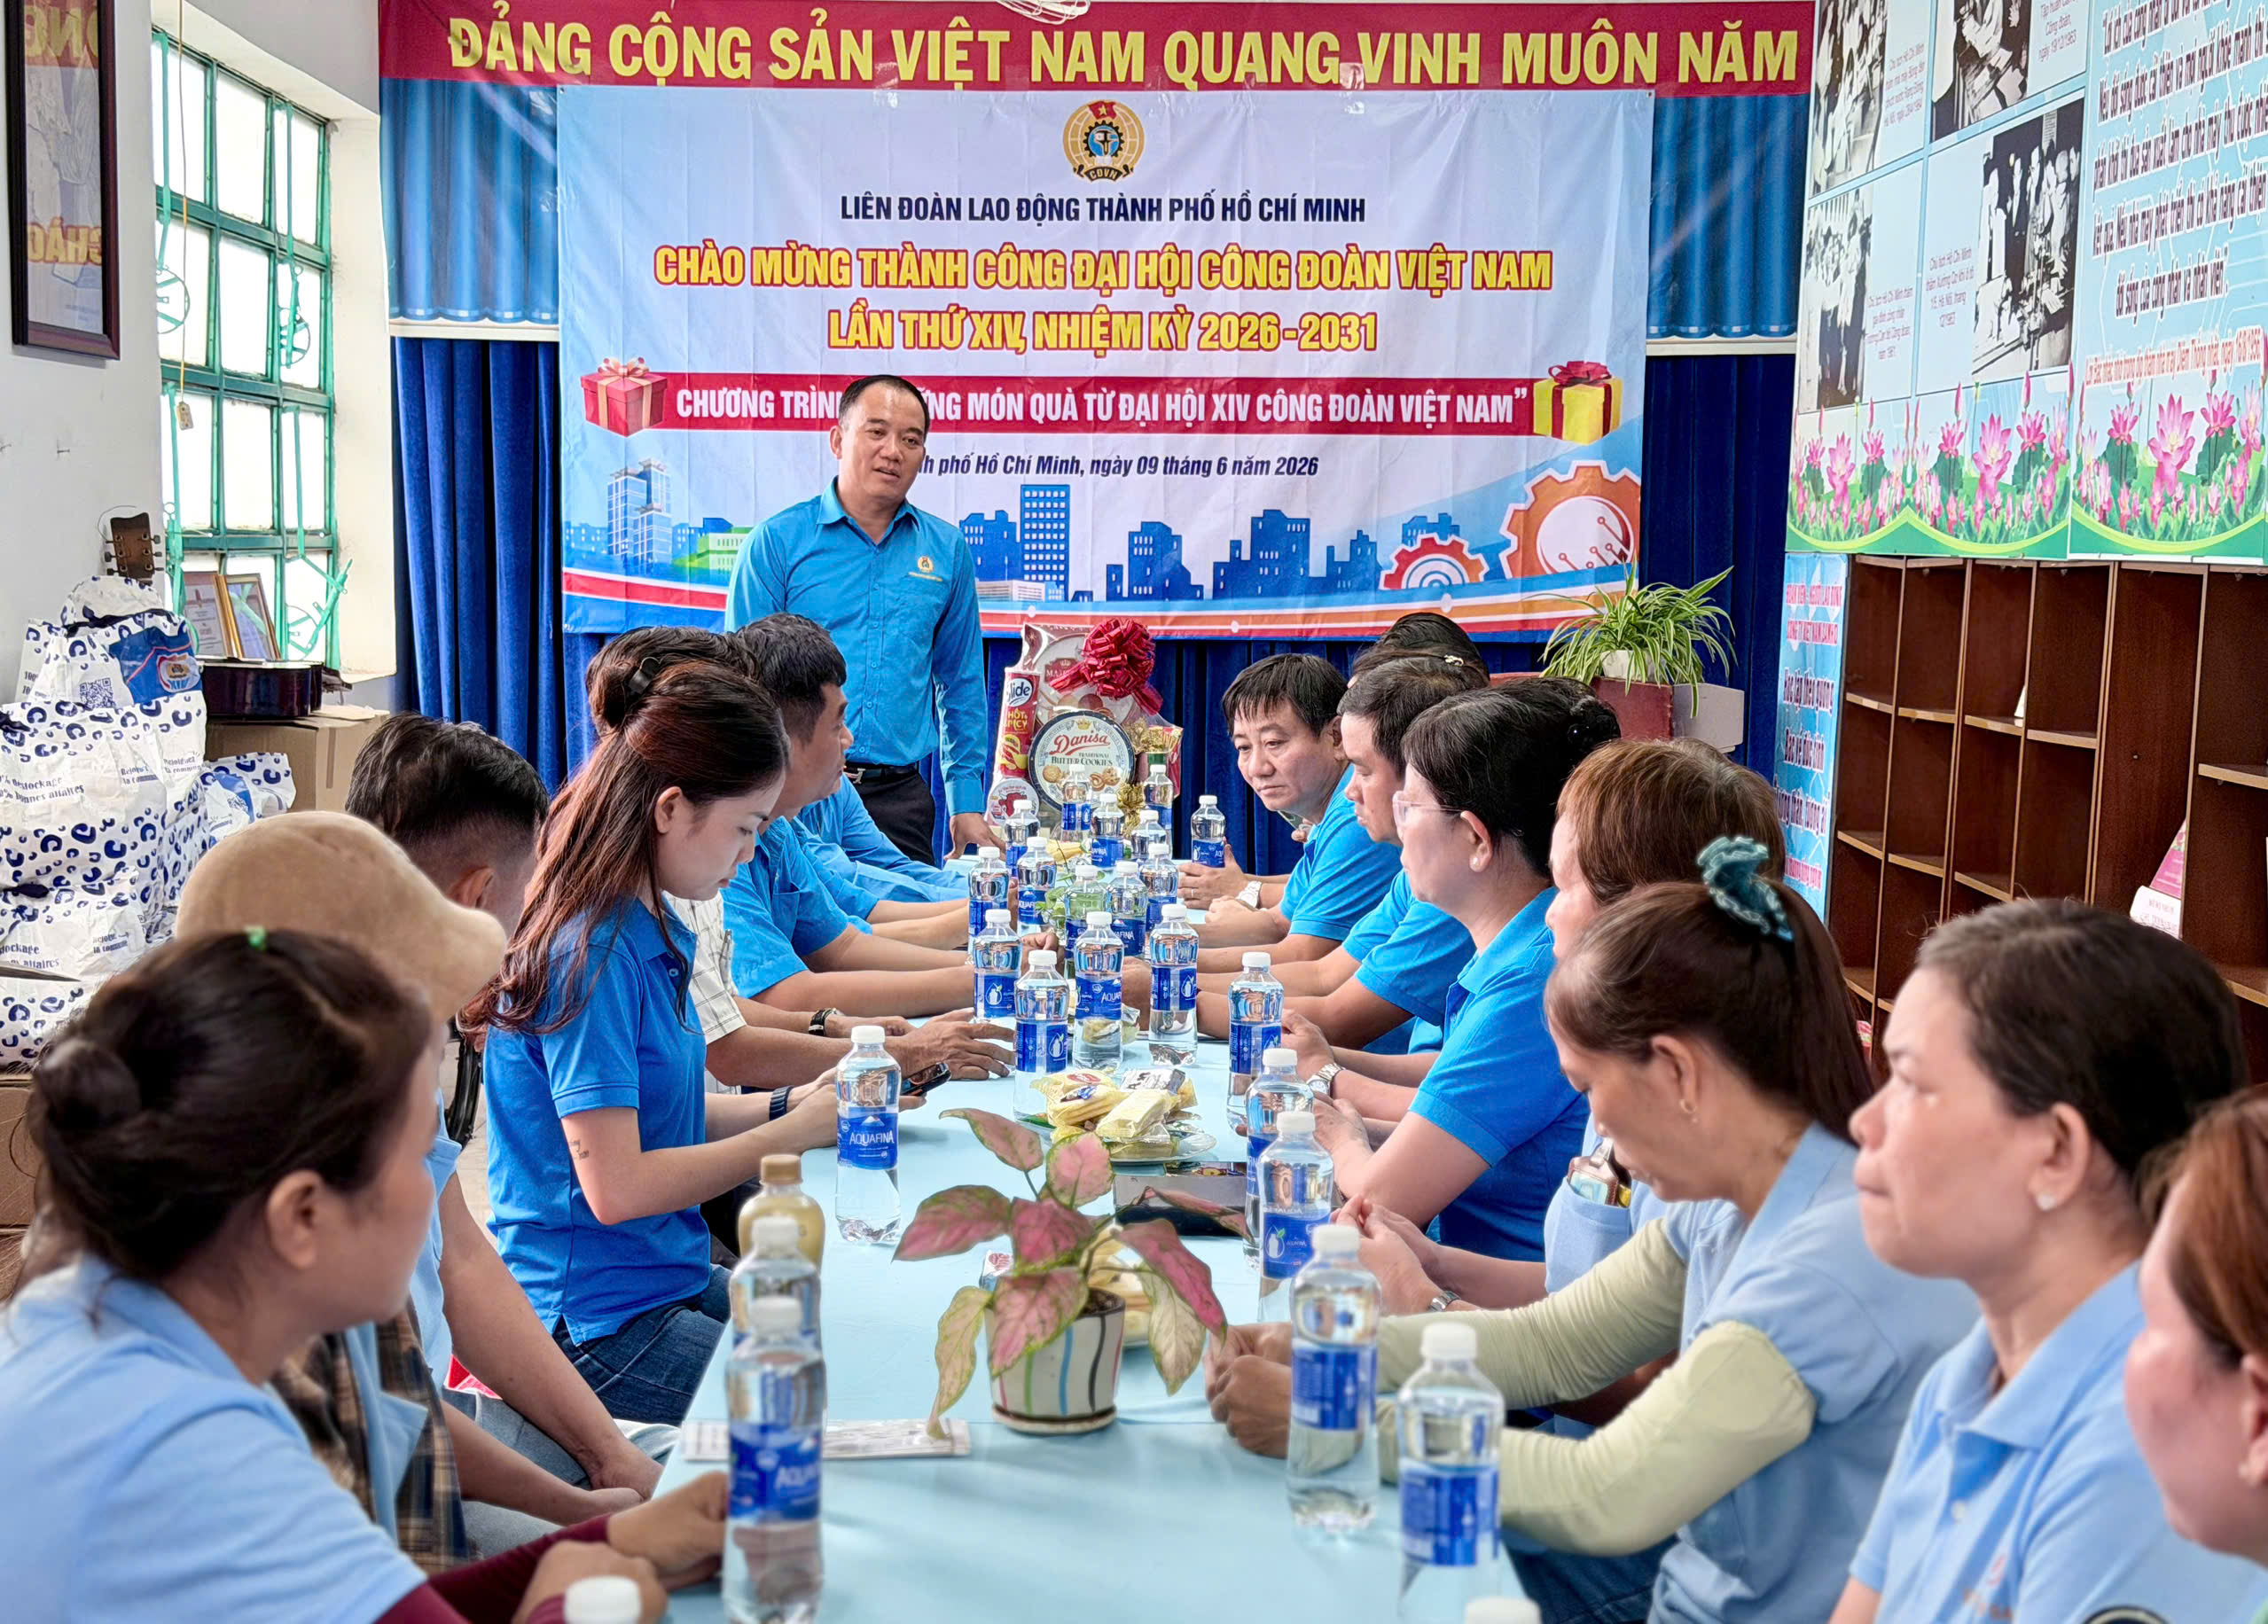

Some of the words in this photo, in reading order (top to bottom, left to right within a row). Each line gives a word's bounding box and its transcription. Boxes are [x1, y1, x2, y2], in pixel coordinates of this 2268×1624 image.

[449, 0, 592, 76] ĐẢNG
[608, 12, 752, 87] CỘNG
[769, 8, 874, 82] SẢN
[892, 16, 1011, 90] VIỆT
[1030, 30, 1146, 83] NAM
[1163, 31, 1341, 92] QUANG
[1357, 32, 1482, 85] VINH
[1502, 18, 1659, 86] MUÔN
[1678, 20, 1798, 83] NĂM
[841, 190, 893, 221] LIÊN
[896, 191, 963, 222] ĐOÀN
[967, 196, 1011, 223] LAO
[1014, 191, 1081, 228] ĐỘNG
[1084, 191, 1163, 223] THÀNH
[1168, 189, 1216, 223] PHỐ
[1220, 189, 1253, 223] HỒ
[1257, 191, 1298, 223] CHÍ
[1302, 197, 1366, 223] MINH
[654, 238, 746, 287] CHÀO
[752, 239, 852, 288] MỪNG
[857, 240, 968, 289] THÀNH
[974, 241, 1067, 290] CÔNG
[1072, 250, 1130, 298] ĐẠI
[1135, 242, 1193, 297] HỘI
[1199, 242, 1292, 291] CÔNG
[1295, 242, 1391, 291] ĐOÀN
[1395, 242, 1467, 298] VIỆT
[1473, 250, 1552, 291] NAM
[828, 298, 894, 349] LẦN
[898, 303, 968, 350] THỨ
[969, 310, 1027, 354] XIV,
[1033, 303, 1143, 358] NHIỆM
[1149, 304, 1194, 351] KỲ
[676, 387, 774, 422] CHƯƠNG
[966, 386, 1025, 422] MÓN
[1029, 386, 1079, 426] QUÀ
[1082, 386, 1118, 422] TỪ
[1117, 393, 1160, 427] ĐẠI
[1164, 388, 1206, 428] HỘI
[1210, 393, 1252, 422] XIV
[1255, 387, 1324, 424] CÔNG
[1327, 388, 1395, 424] ĐOÀN
[1399, 387, 1451, 430] VIỆT
[937, 450, 973, 477] phố
[974, 452, 1000, 475] Hồ
[1002, 454, 1032, 475] Chí
[1033, 455, 1085, 479] Minh,
[1089, 457, 1134, 479] ngày
[1136, 455, 1160, 475] 09
[1161, 455, 1214, 479] tháng
[1216, 456, 1229, 476] 6
[1231, 457, 1271, 476] năm
[1273, 456, 1320, 477] 2026
[1049, 732, 1111, 755] Danisa
[849, 1130, 895, 1146] AQUAFINA
